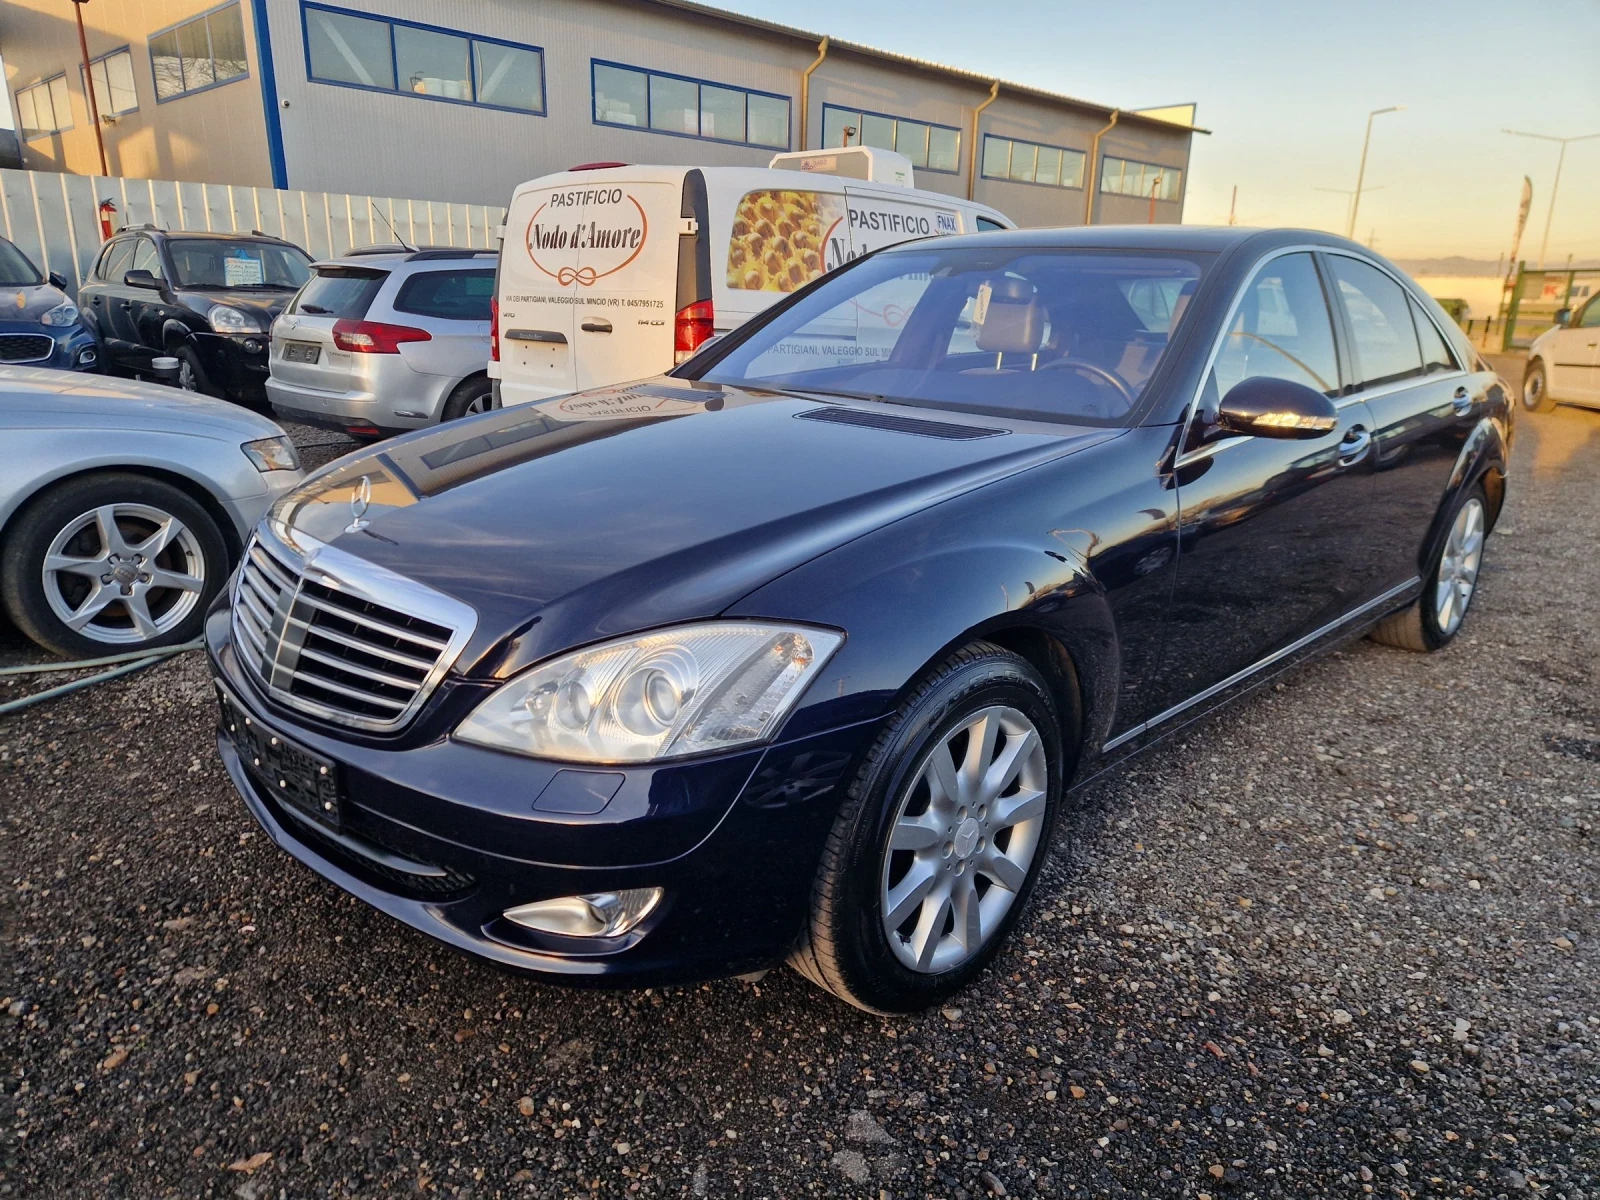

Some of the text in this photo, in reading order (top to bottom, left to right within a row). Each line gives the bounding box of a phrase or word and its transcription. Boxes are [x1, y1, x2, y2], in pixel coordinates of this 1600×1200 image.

[550, 188, 622, 207] PASTIFICIO
[848, 209, 930, 235] PASTIFICIO
[937, 215, 956, 231] FNAX
[529, 221, 641, 249] Nodo d'Amore
[548, 296, 573, 304] VALEGGIO
[575, 297, 585, 305] SUL
[607, 298, 620, 307] (VR)
[627, 299, 664, 308] 045/7951725
[821, 345, 863, 356] VALEGGIO
[865, 347, 880, 357] SUL
